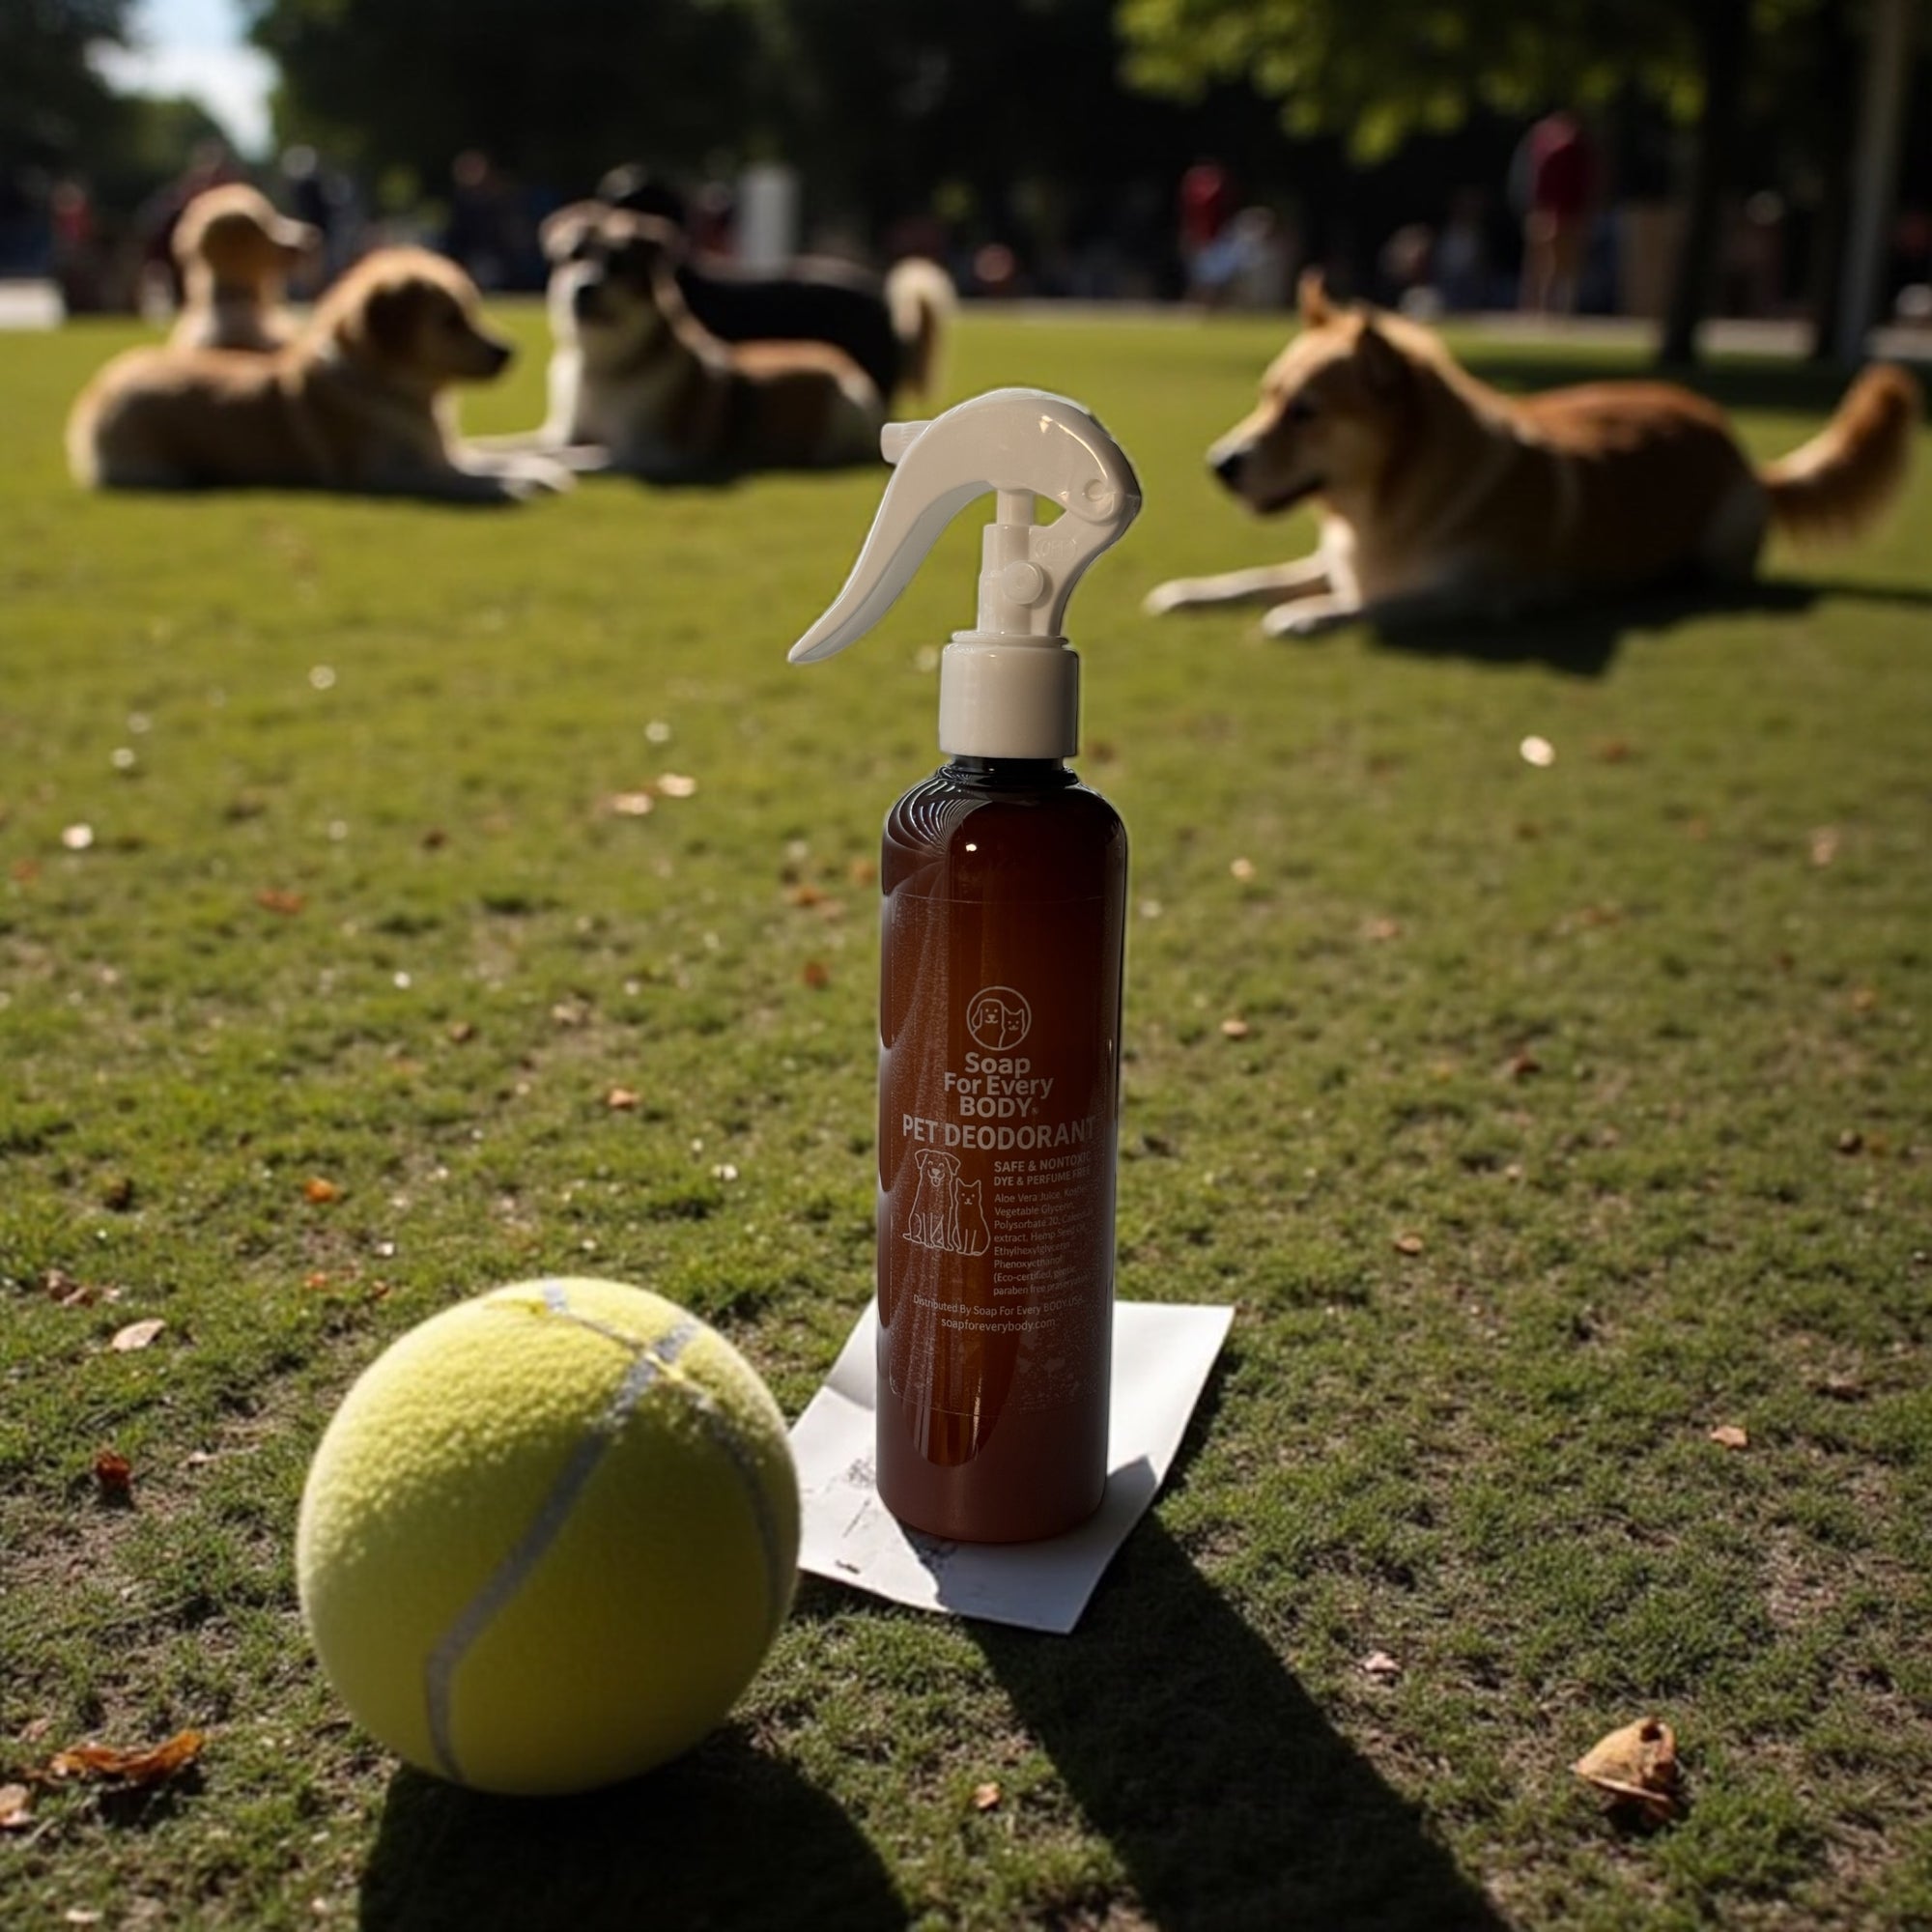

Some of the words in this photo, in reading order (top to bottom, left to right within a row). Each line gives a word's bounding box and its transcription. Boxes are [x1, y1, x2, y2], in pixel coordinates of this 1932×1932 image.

[965, 1051, 1031, 1079] Soap
[944, 1071, 981, 1095] For
[986, 1075, 1054, 1099] Every
[902, 1113, 943, 1143] PET
[944, 1116, 1095, 1151] DEODORANT
[994, 1160, 1025, 1173] SAFE
[1028, 1159, 1037, 1172] &
[1039, 1151, 1092, 1170] NONTOXIC
[993, 1176, 1014, 1186] DYE
[1016, 1176, 1024, 1185] &
[1027, 1171, 1071, 1185] PERFUME
[1072, 1165, 1091, 1179] FREE
[994, 1193, 1015, 1203] Aloe
[1017, 1193, 1037, 1203] Vera
[994, 1206, 1039, 1218] Vegetable
[994, 1218, 1046, 1232] Polysorbate
[1031, 1231, 1056, 1241] Hemp
[993, 1287, 1028, 1296] paraben
[1030, 1284, 1046, 1293] free
[913, 1293, 958, 1314] Distributed
[959, 1304, 972, 1316] By
[974, 1305, 996, 1319] Soap
[999, 1306, 1014, 1316] For
[1016, 1304, 1040, 1317] Every
[941, 1317, 1056, 1334] soapforeverybody.com
